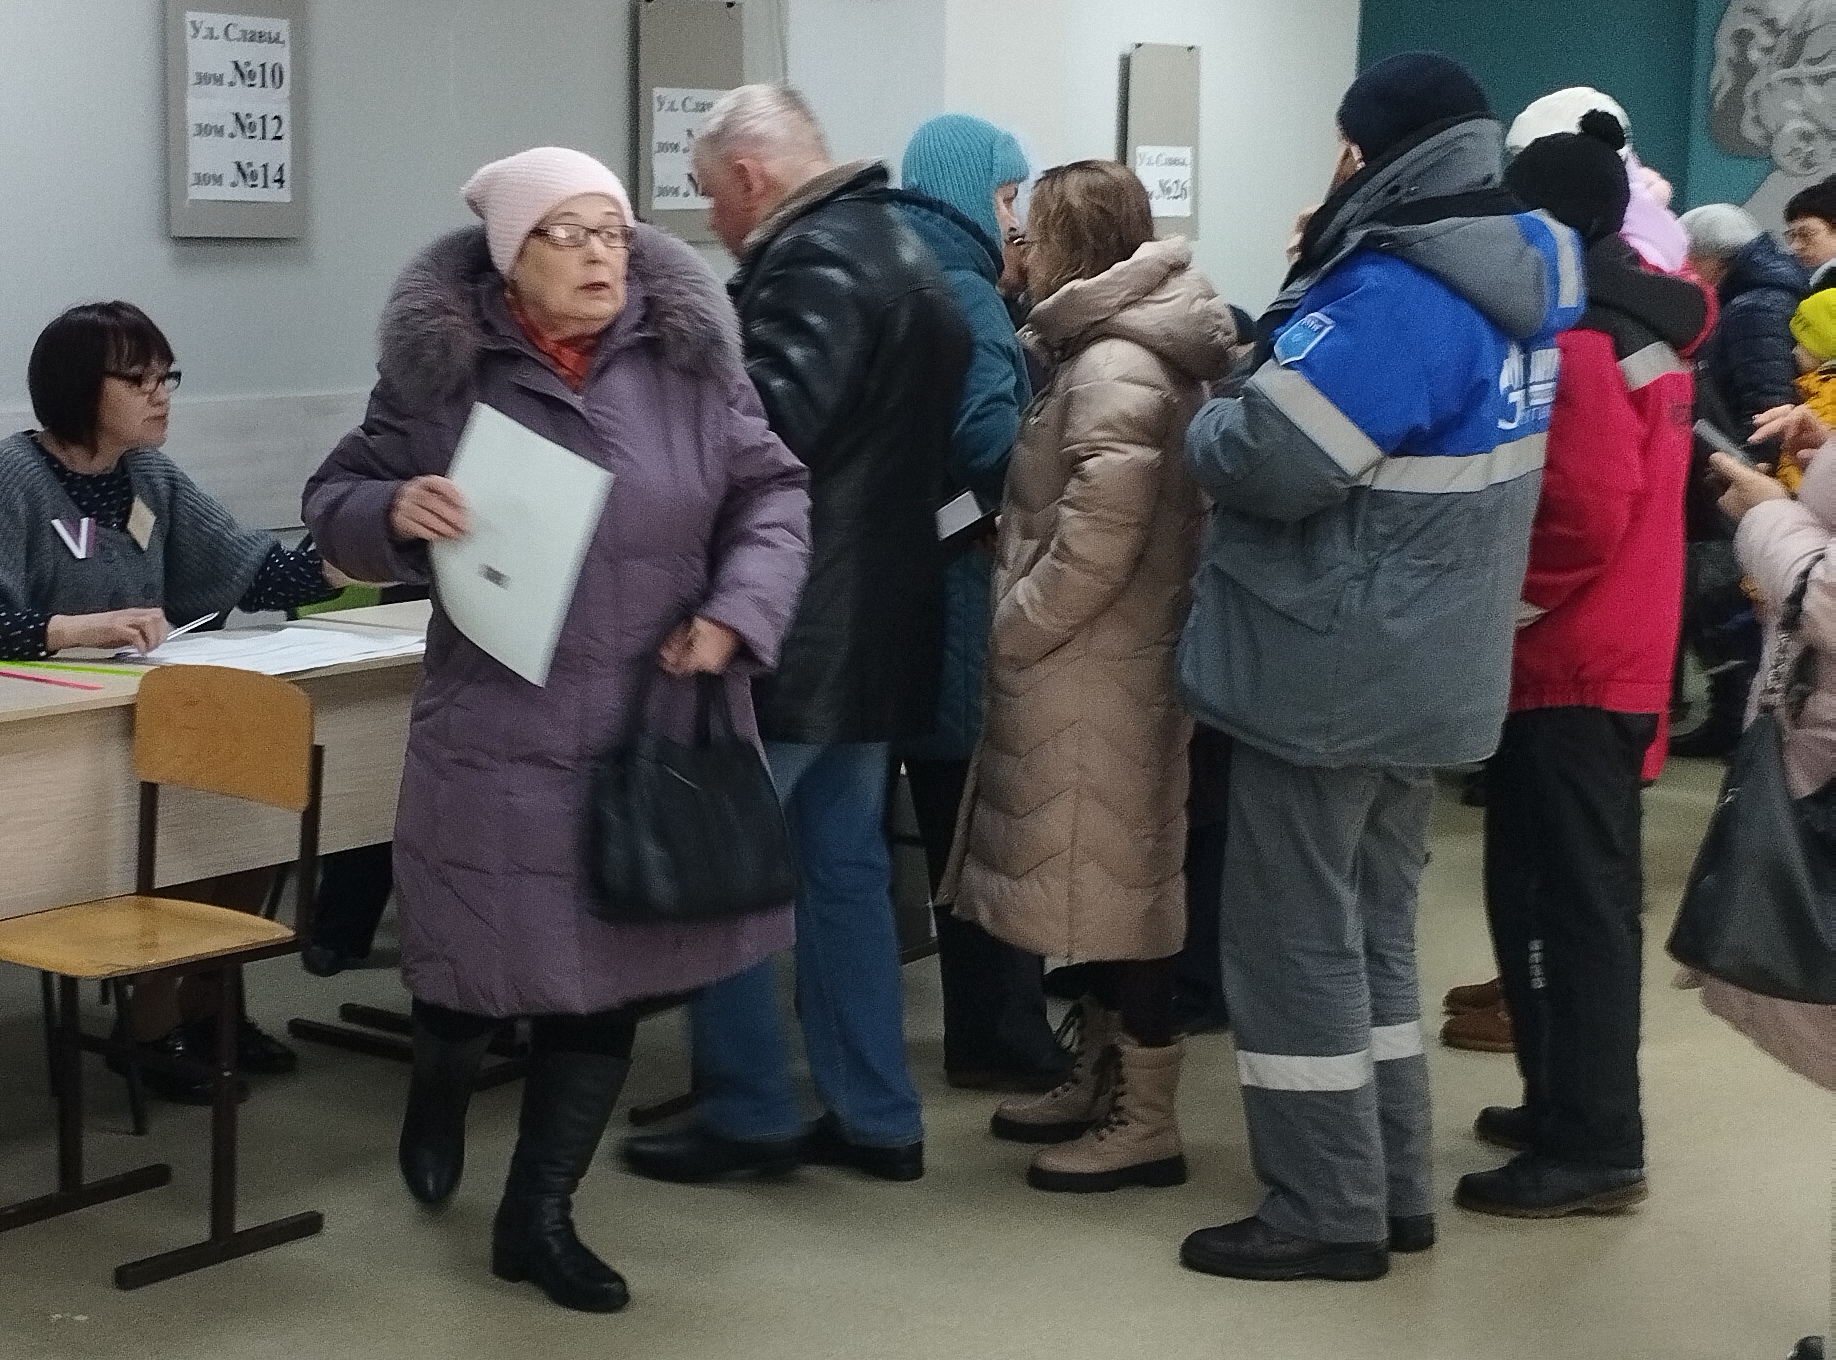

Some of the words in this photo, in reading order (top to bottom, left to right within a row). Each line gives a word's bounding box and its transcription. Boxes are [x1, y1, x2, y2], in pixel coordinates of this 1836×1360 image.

[227, 59, 285, 90] №10
[227, 111, 284, 141] №12
[229, 160, 286, 190] №14
